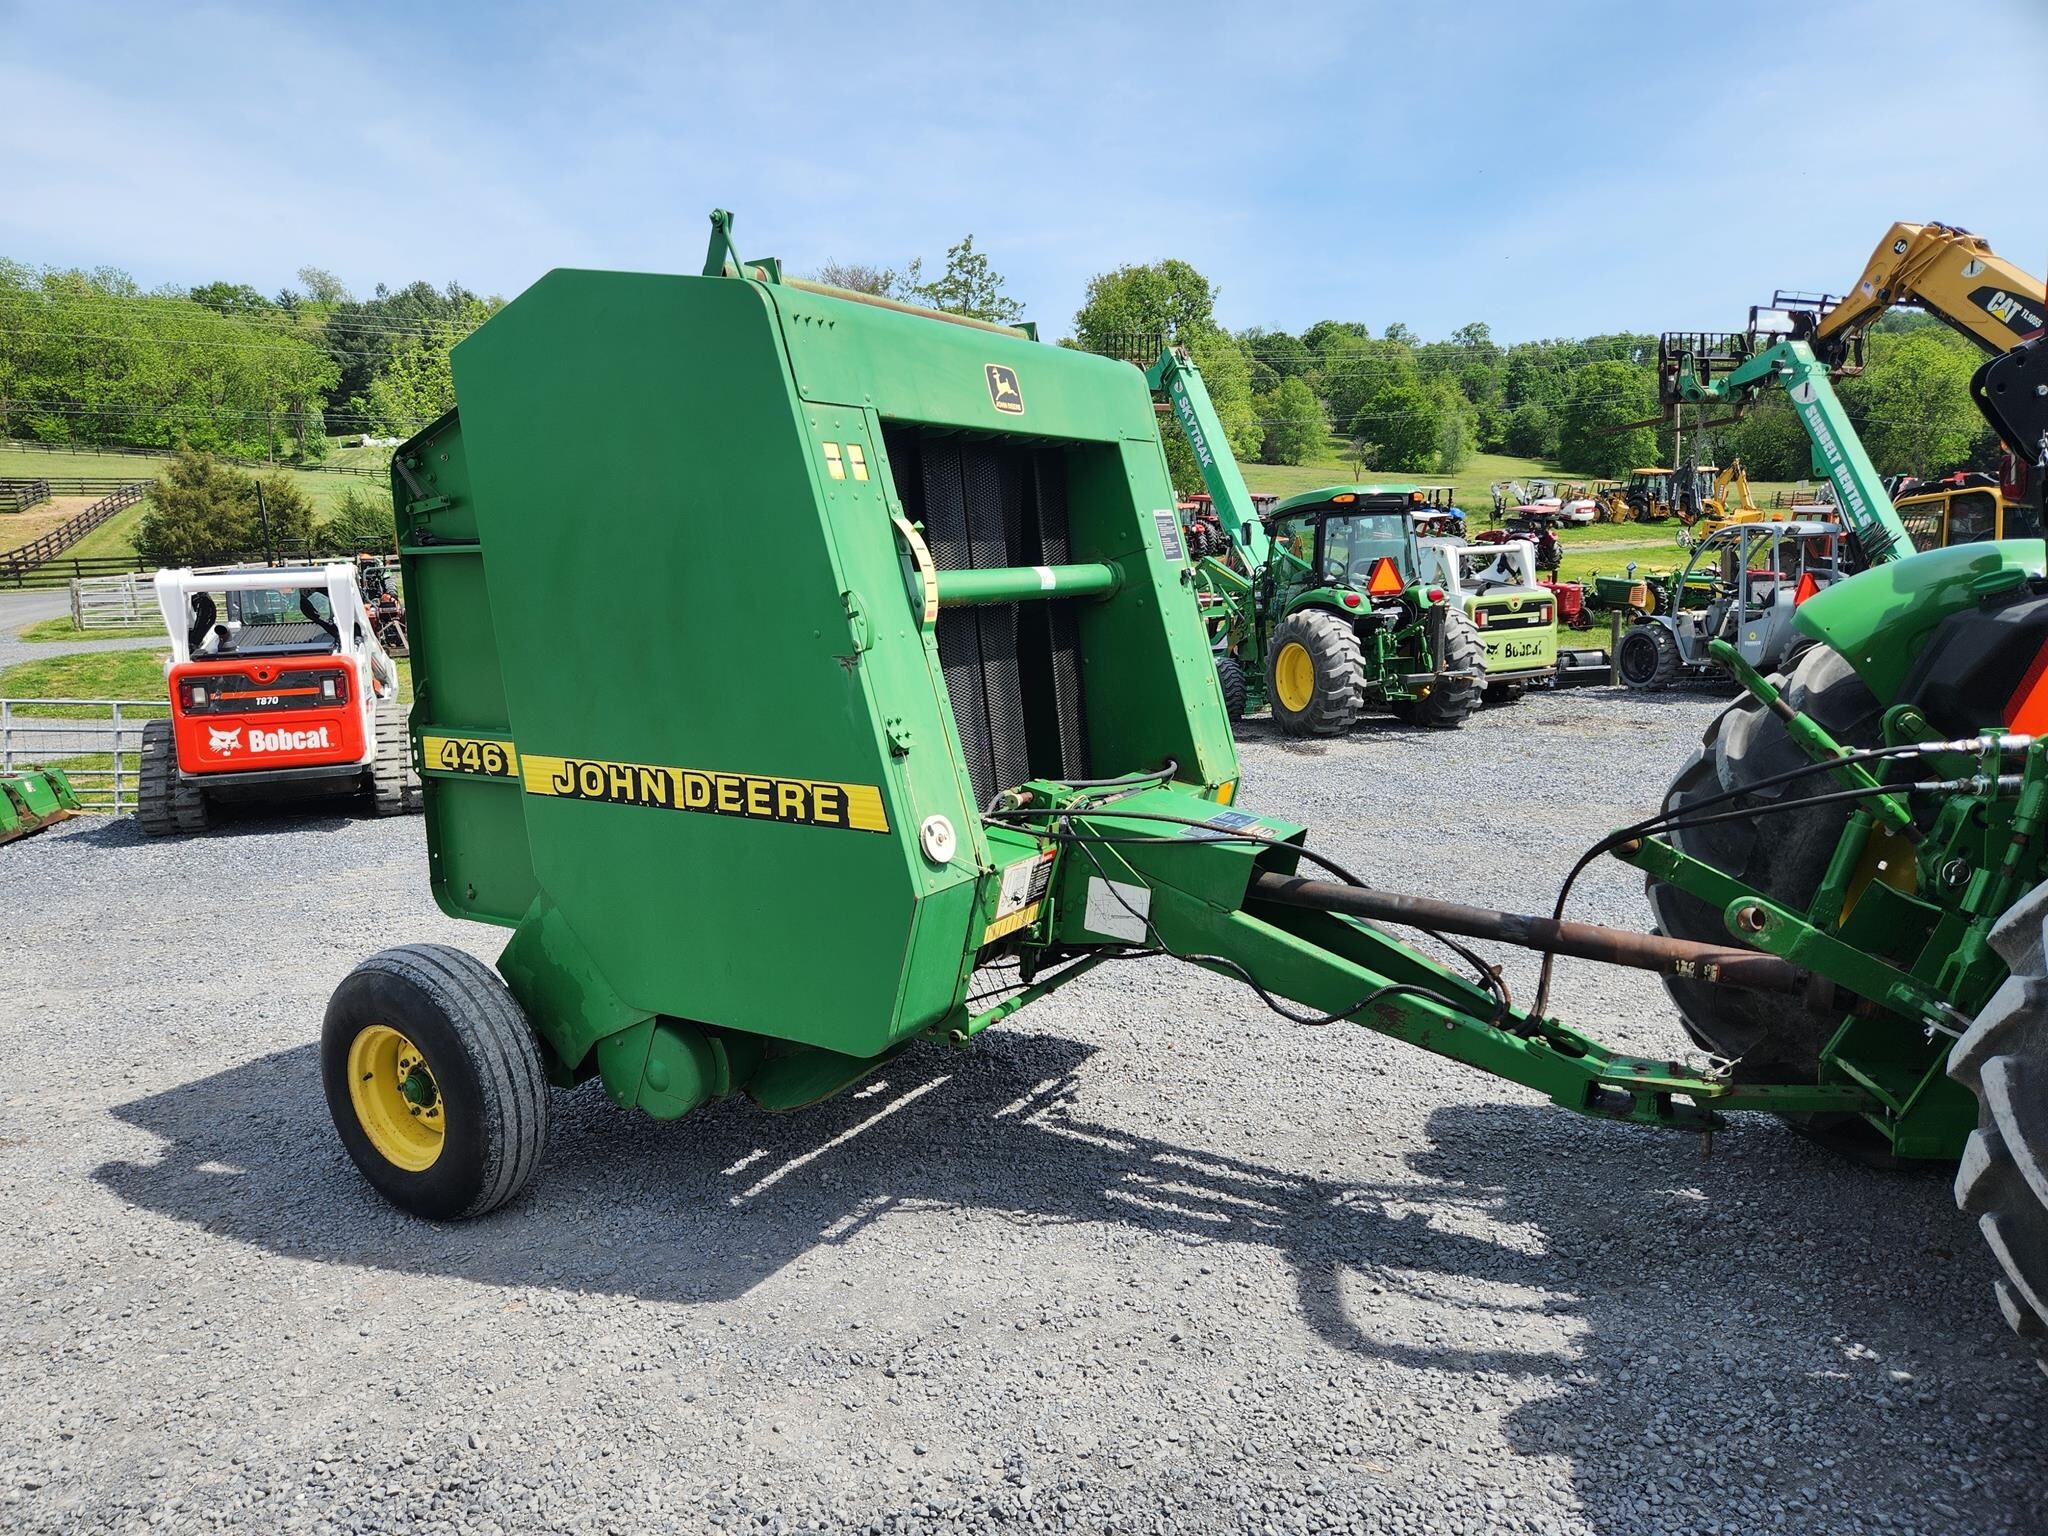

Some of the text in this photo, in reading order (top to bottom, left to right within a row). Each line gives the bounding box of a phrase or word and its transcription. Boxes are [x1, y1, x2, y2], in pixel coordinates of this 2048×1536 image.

[1895, 241, 1907, 253] 10
[1987, 291, 2023, 324] CAT
[1179, 396, 1213, 468] SKYTRAK
[1804, 404, 1873, 528] SUNBELT RENTALS
[256, 696, 279, 706] T870
[248, 726, 330, 753] Bobcat
[440, 740, 505, 774] 446
[552, 761, 843, 824] JOHN DEERE
